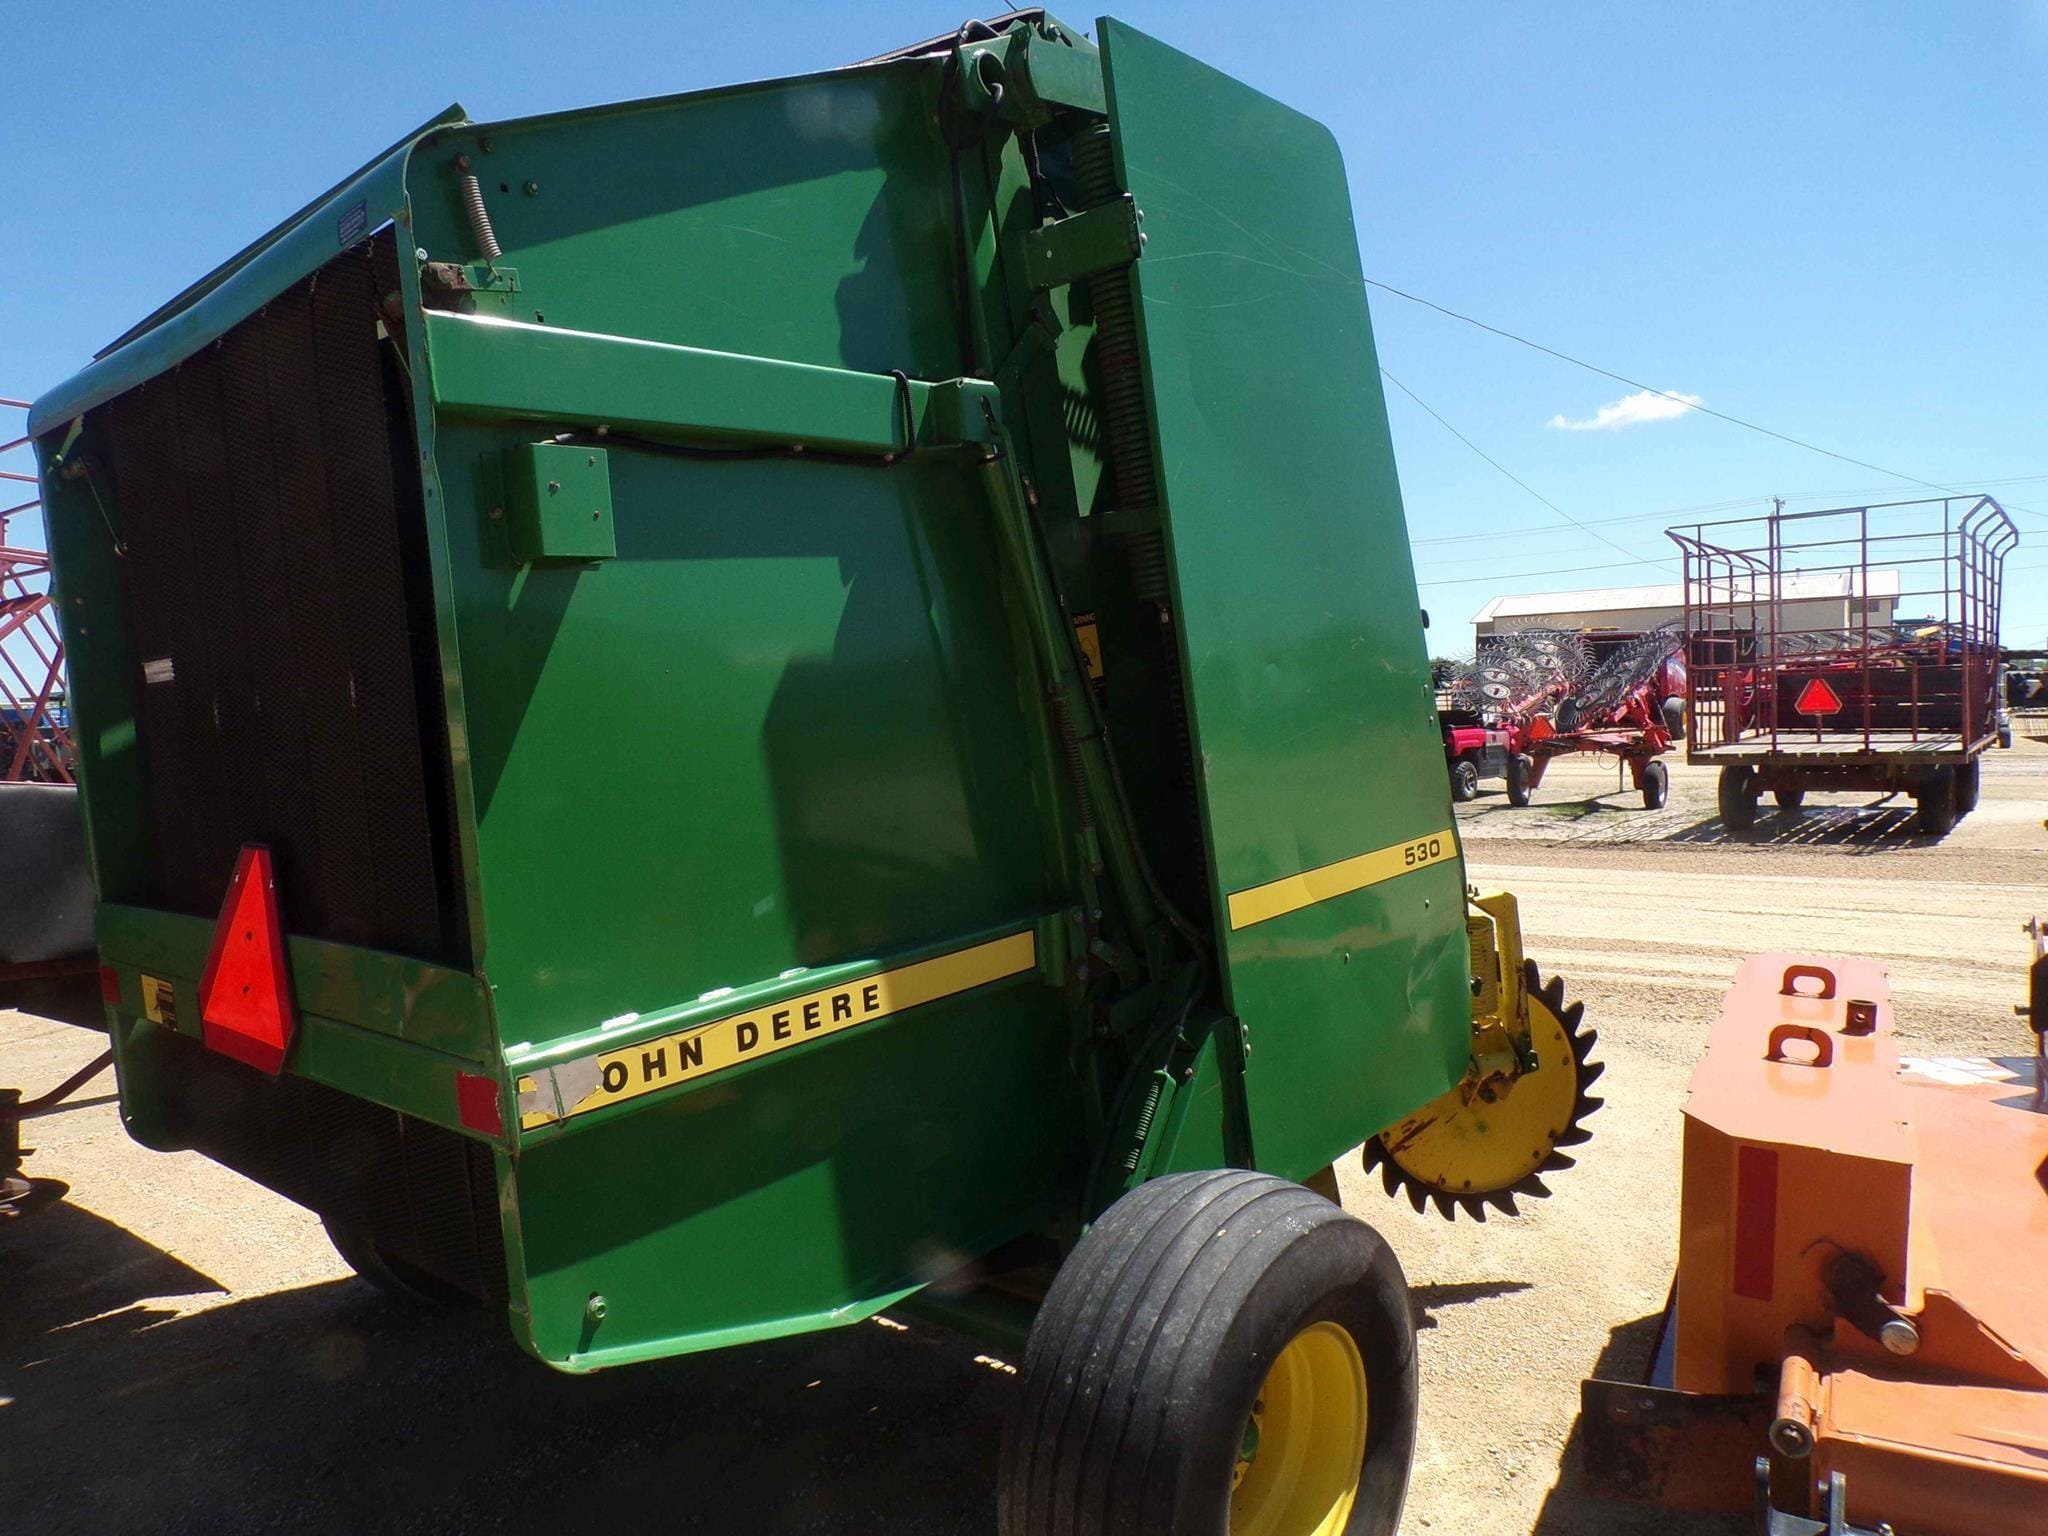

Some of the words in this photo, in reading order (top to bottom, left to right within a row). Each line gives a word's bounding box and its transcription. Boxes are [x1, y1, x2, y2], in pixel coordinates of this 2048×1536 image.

[1405, 839, 1441, 866] 530
[602, 1037, 704, 1093] OHN
[736, 984, 880, 1053] DEERE
